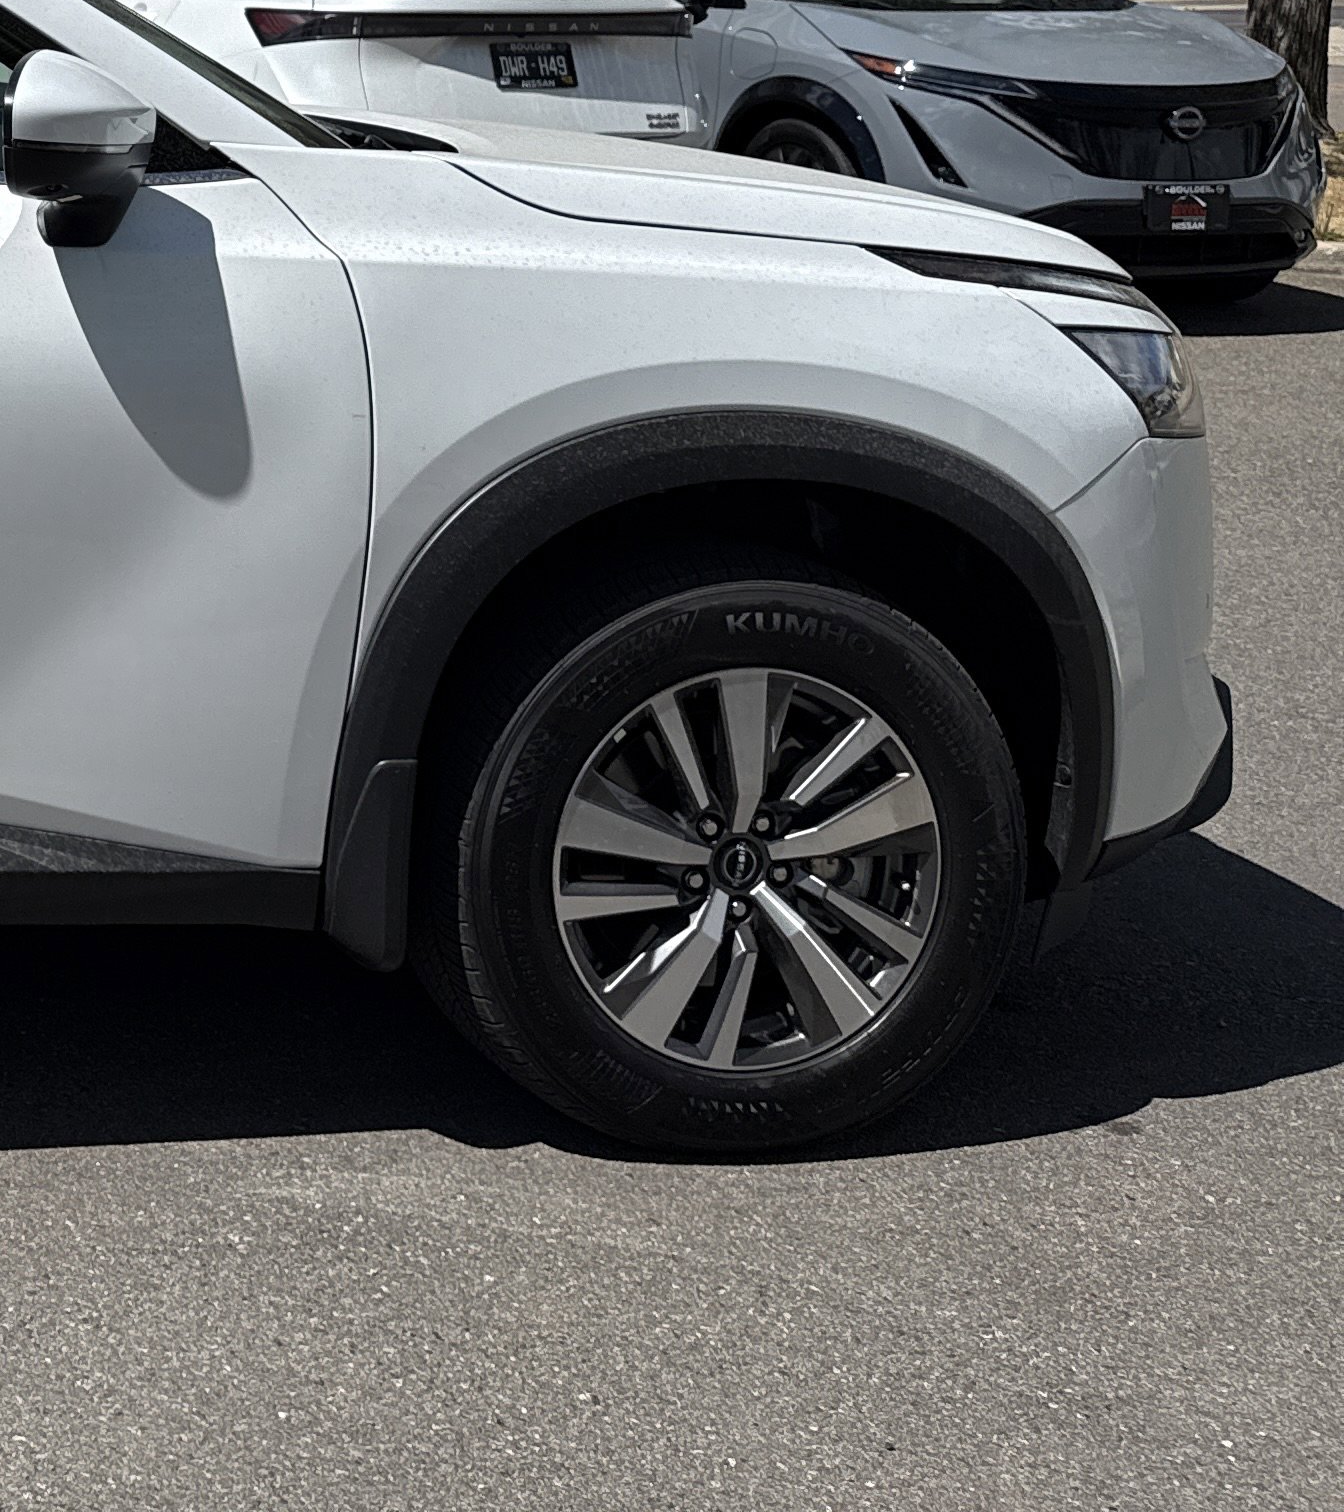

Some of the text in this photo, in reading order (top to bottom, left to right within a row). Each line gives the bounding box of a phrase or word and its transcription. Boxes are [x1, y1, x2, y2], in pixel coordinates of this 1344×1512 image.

[483, 22, 599, 32] NISSAN
[499, 54, 568, 77] DWR H49
[1171, 221, 1206, 230] NISSAN
[725, 611, 875, 656] KUMHO
